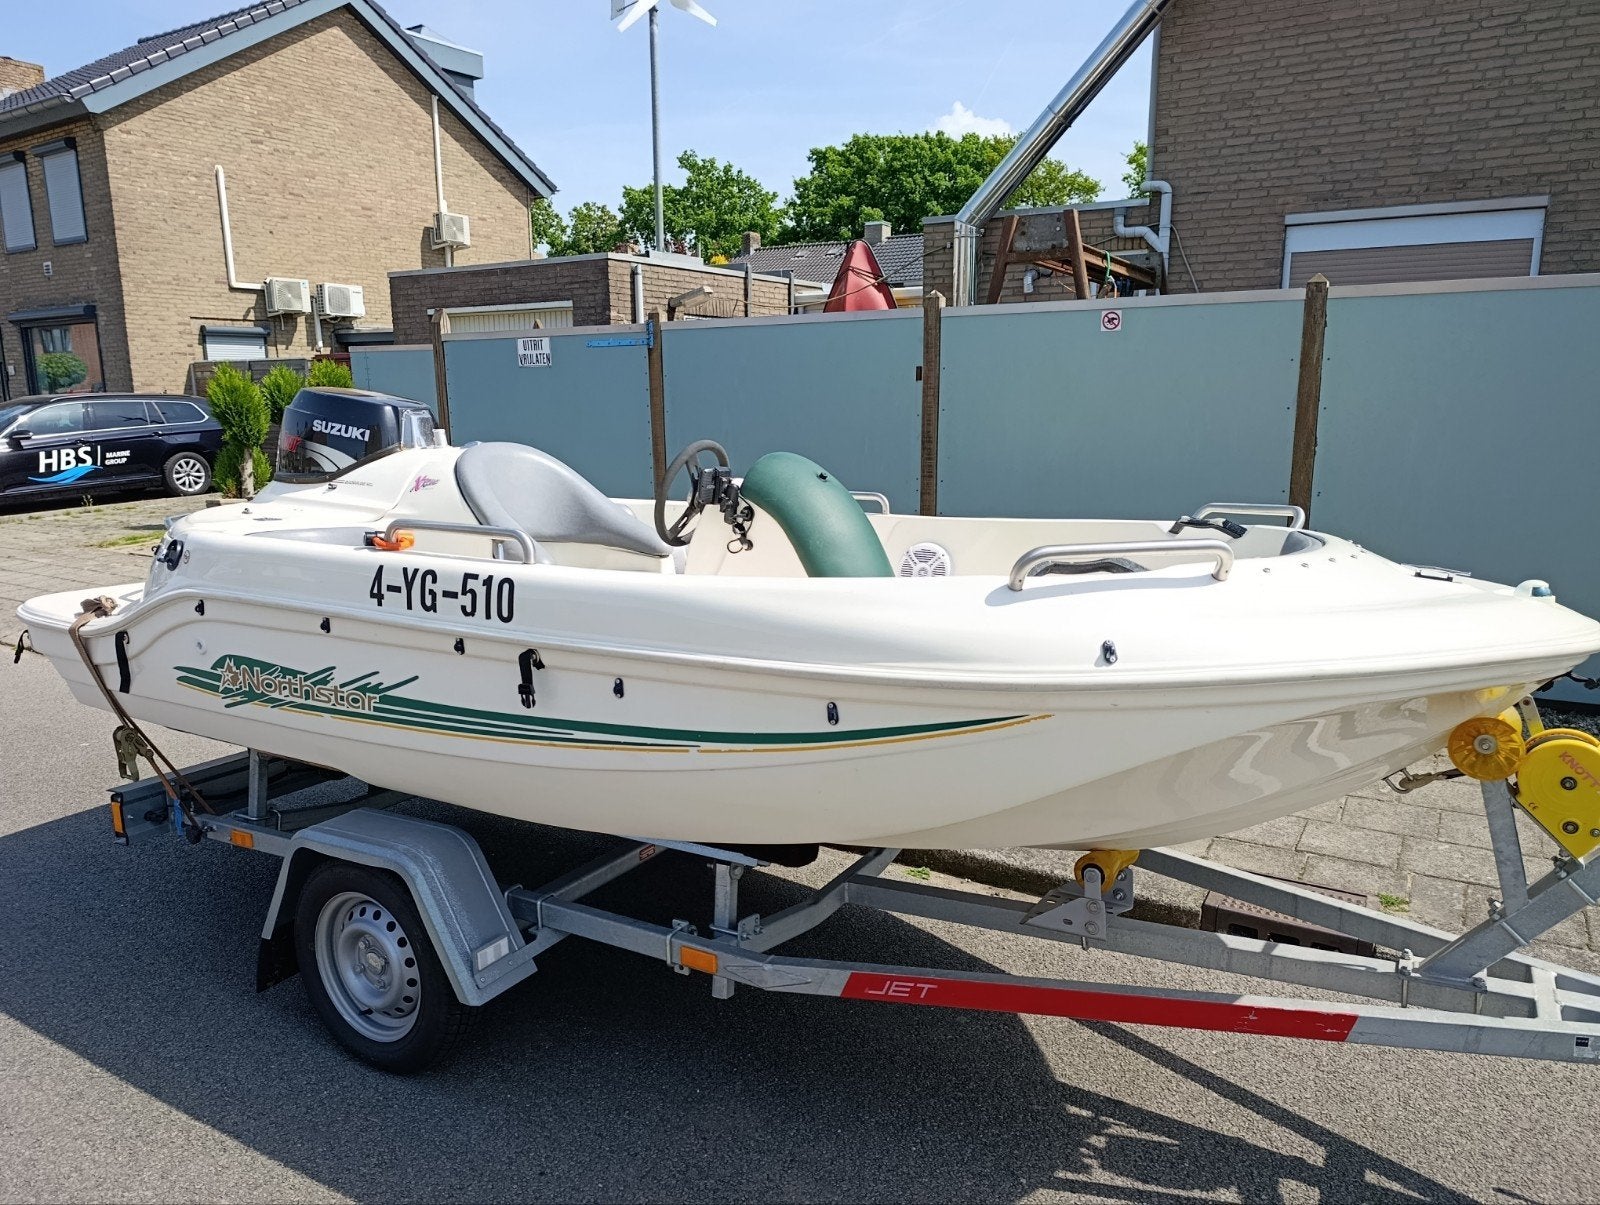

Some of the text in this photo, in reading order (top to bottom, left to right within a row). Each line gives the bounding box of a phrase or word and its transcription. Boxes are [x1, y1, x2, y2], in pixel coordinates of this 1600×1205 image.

[522, 339, 543, 351] UITRIT
[312, 419, 371, 442] SUZUKI
[39, 446, 93, 473] HBS
[104, 457, 128, 466] GROUP
[105, 450, 131, 459] MARINE
[369, 564, 515, 623] 4-YG-510
[240, 664, 380, 713] Northstar
[864, 980, 938, 999] JET
